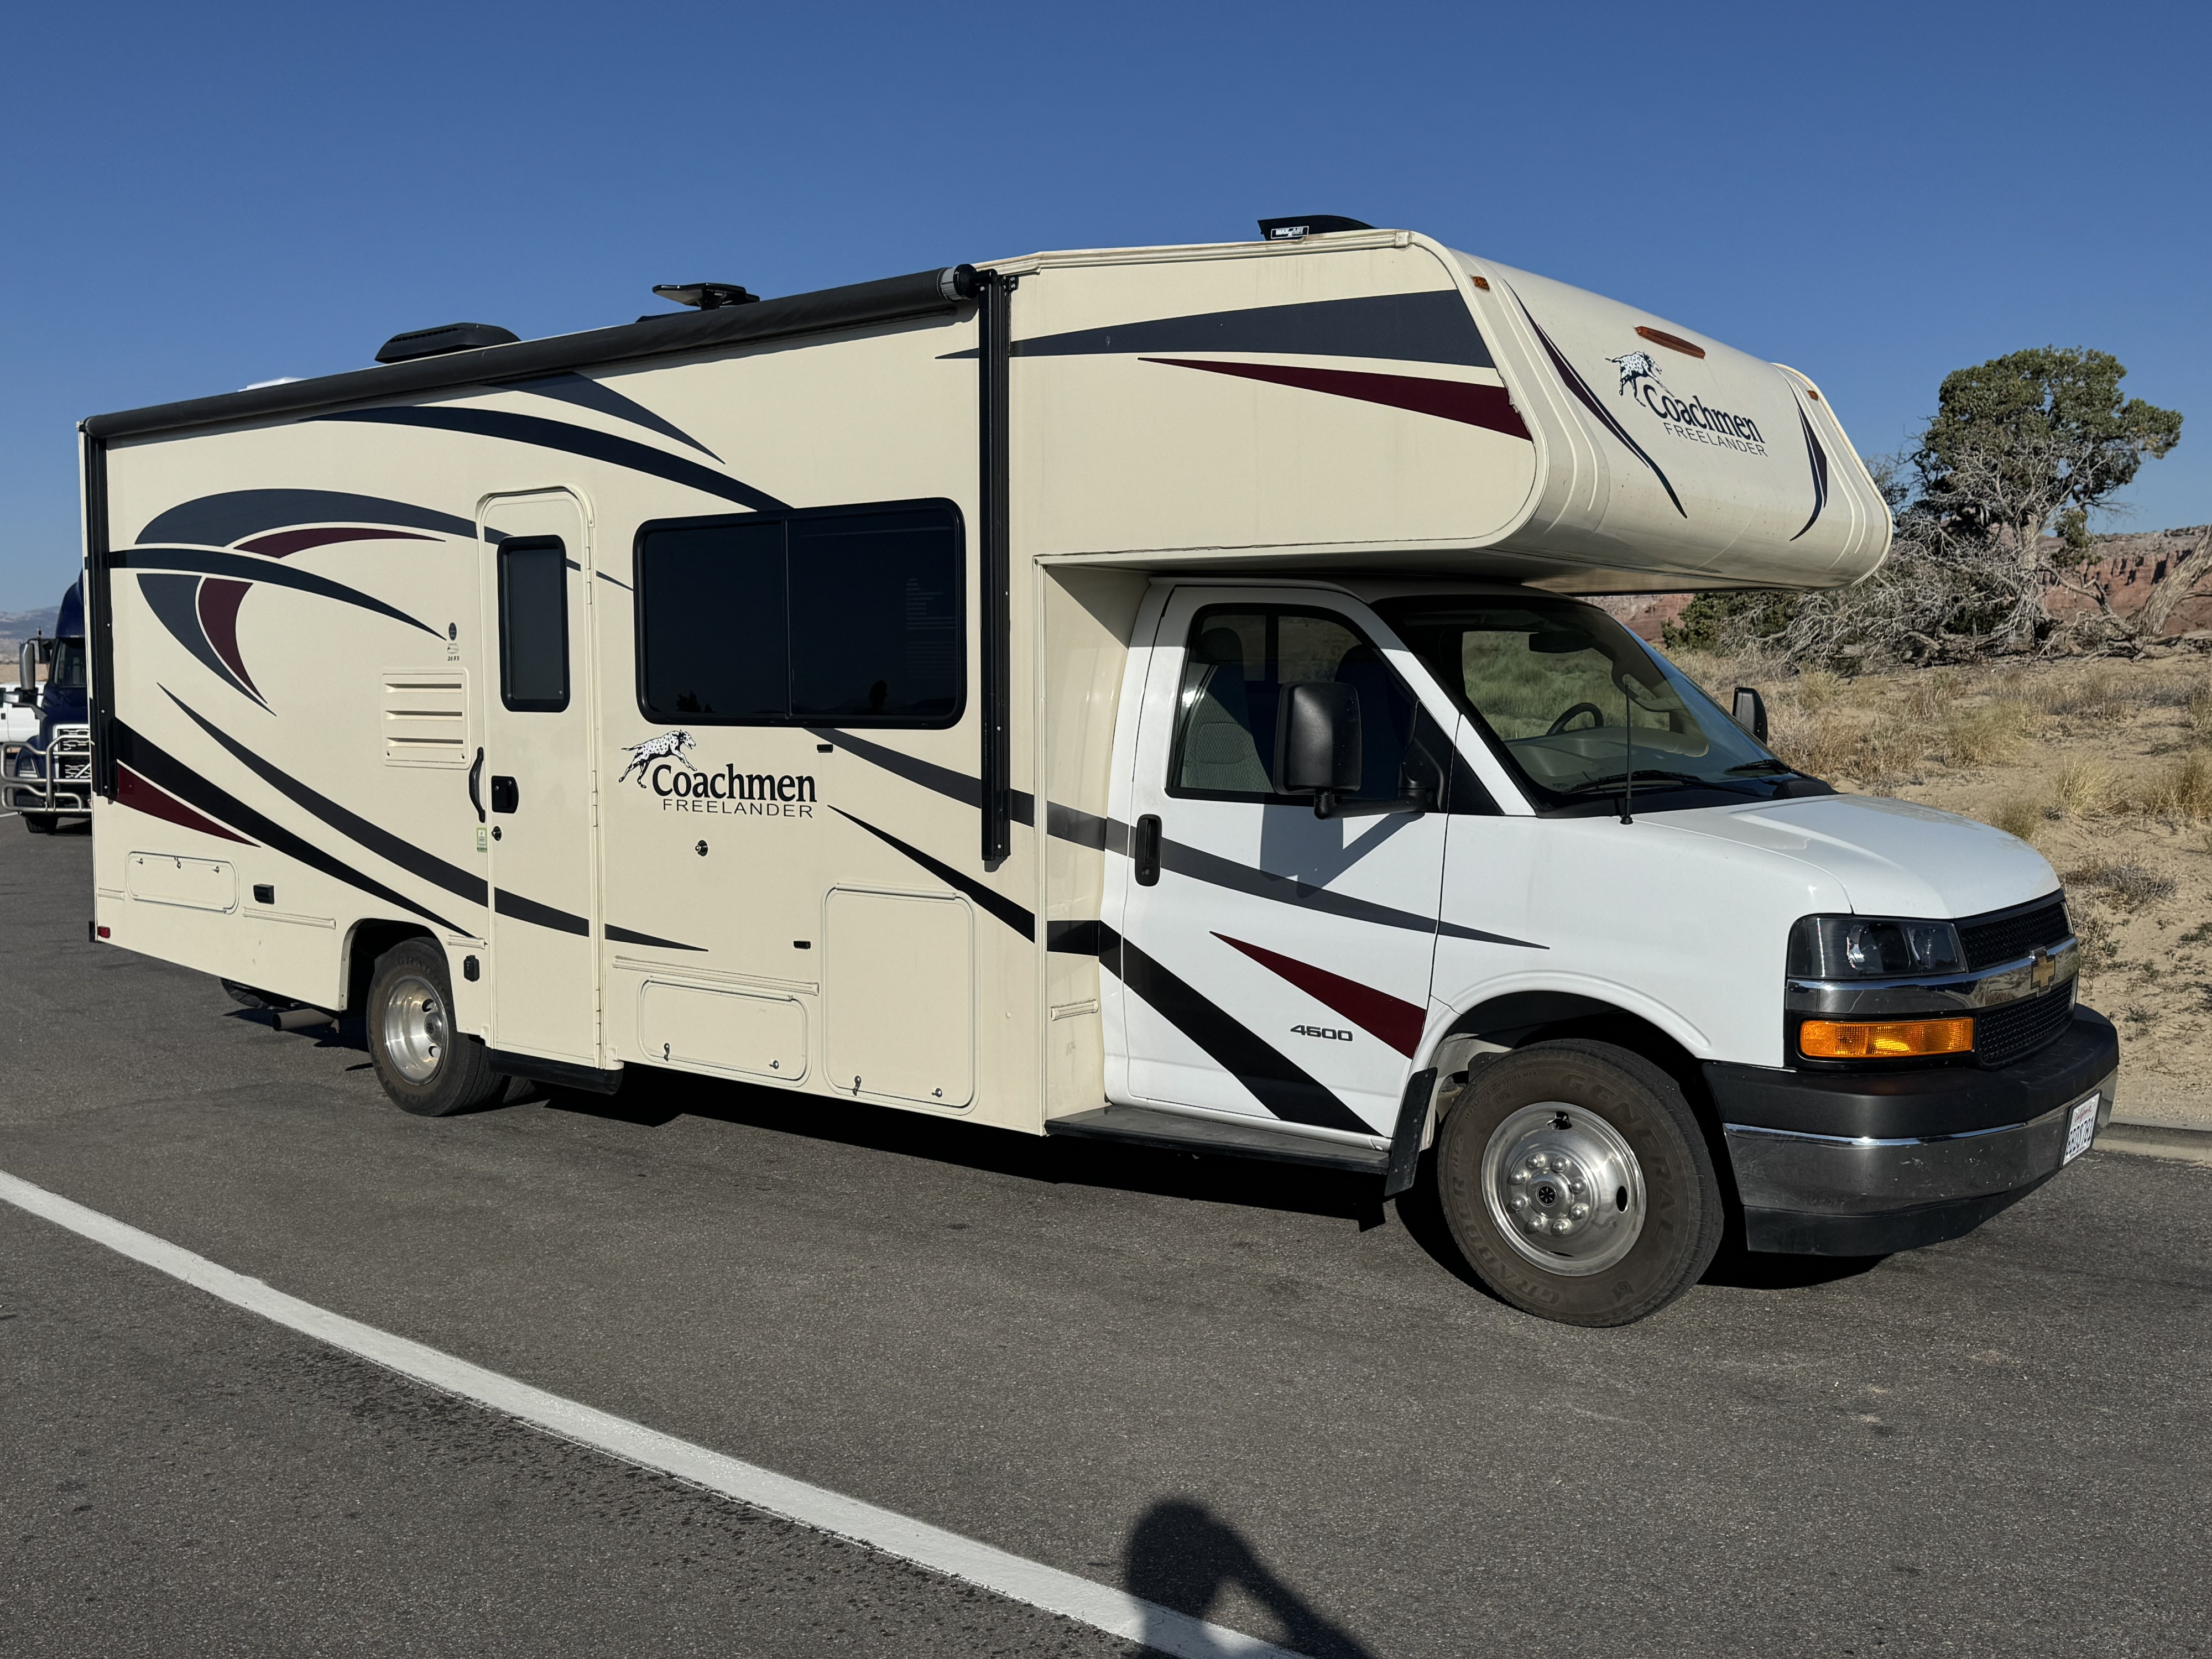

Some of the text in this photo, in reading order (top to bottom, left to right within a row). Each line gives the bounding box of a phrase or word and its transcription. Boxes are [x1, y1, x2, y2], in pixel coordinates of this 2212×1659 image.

[1643, 384, 1765, 444] Coachmen
[1663, 422, 1768, 457] FREELANDER
[652, 763, 817, 802] Coachmen
[663, 799, 813, 818] FREELANDER
[1290, 1024, 1353, 1042] 4500
[1562, 1073, 1677, 1233] GENERAL
